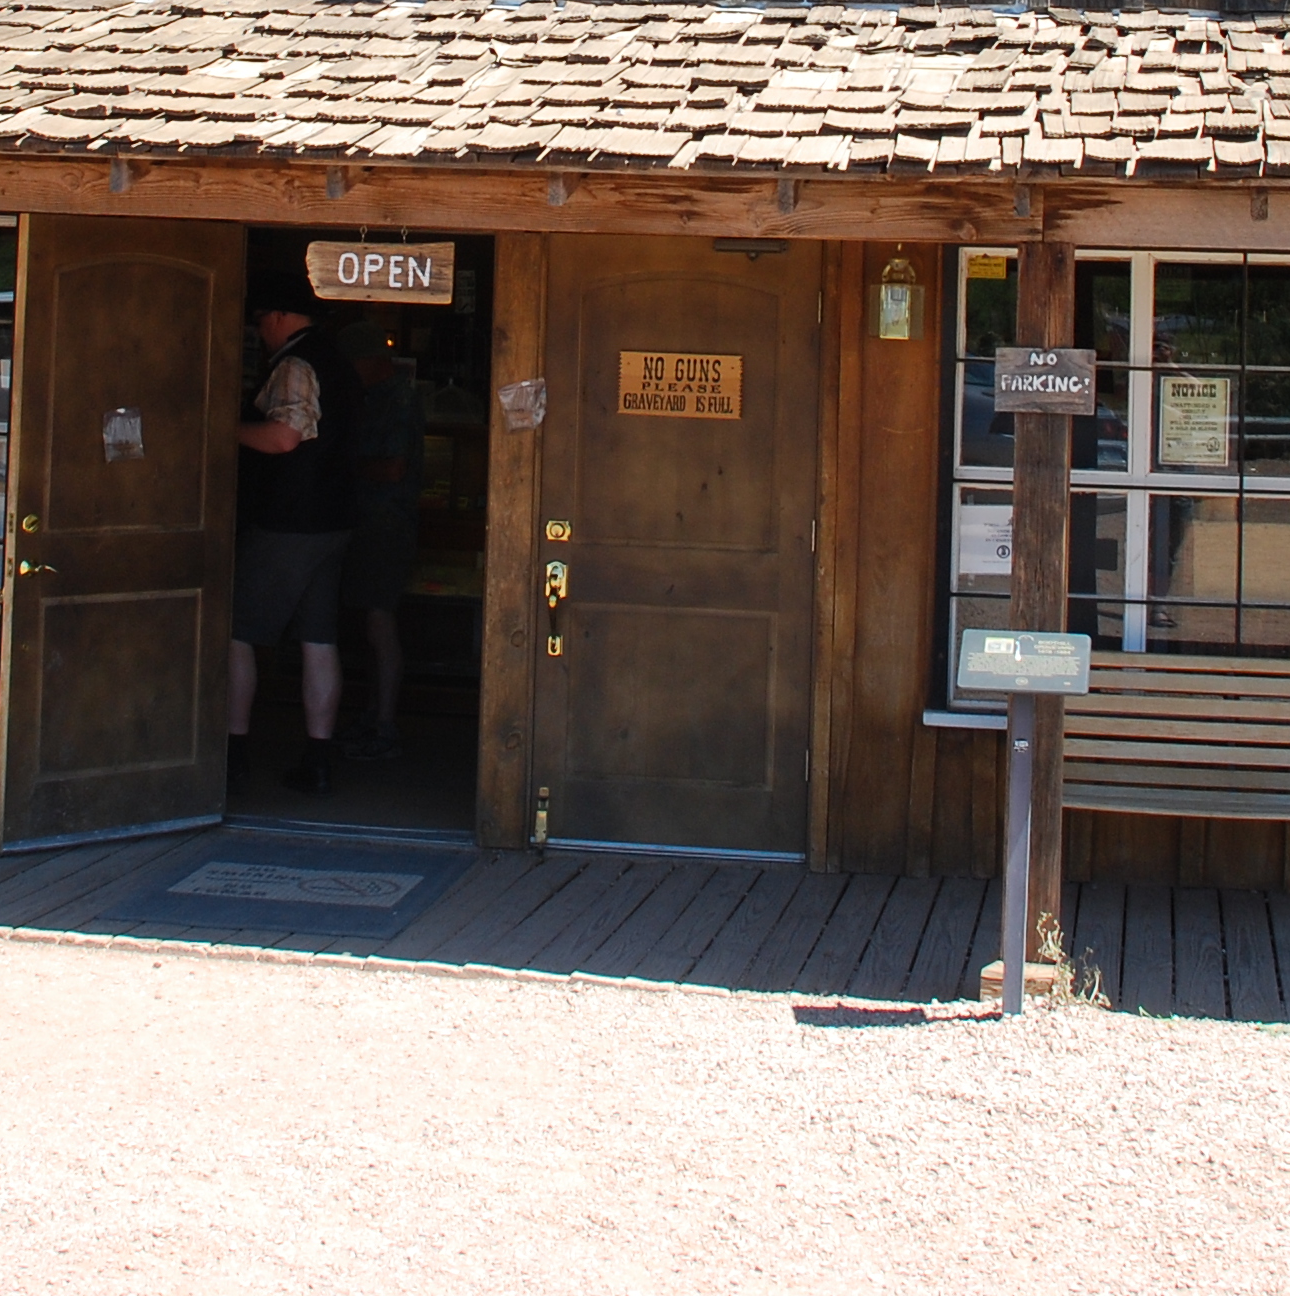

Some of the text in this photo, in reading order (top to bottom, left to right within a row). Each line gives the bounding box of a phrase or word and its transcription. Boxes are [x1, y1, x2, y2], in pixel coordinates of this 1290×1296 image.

[338, 252, 431, 288] OPEN
[1029, 352, 1058, 365] NO
[643, 356, 721, 383] NO GUNS
[641, 382, 722, 394] PLEASE
[1001, 374, 1090, 395] PARKING!
[1171, 384, 1217, 398] NOTICE
[623, 392, 733, 414] GRAVEYARD IS FULL
